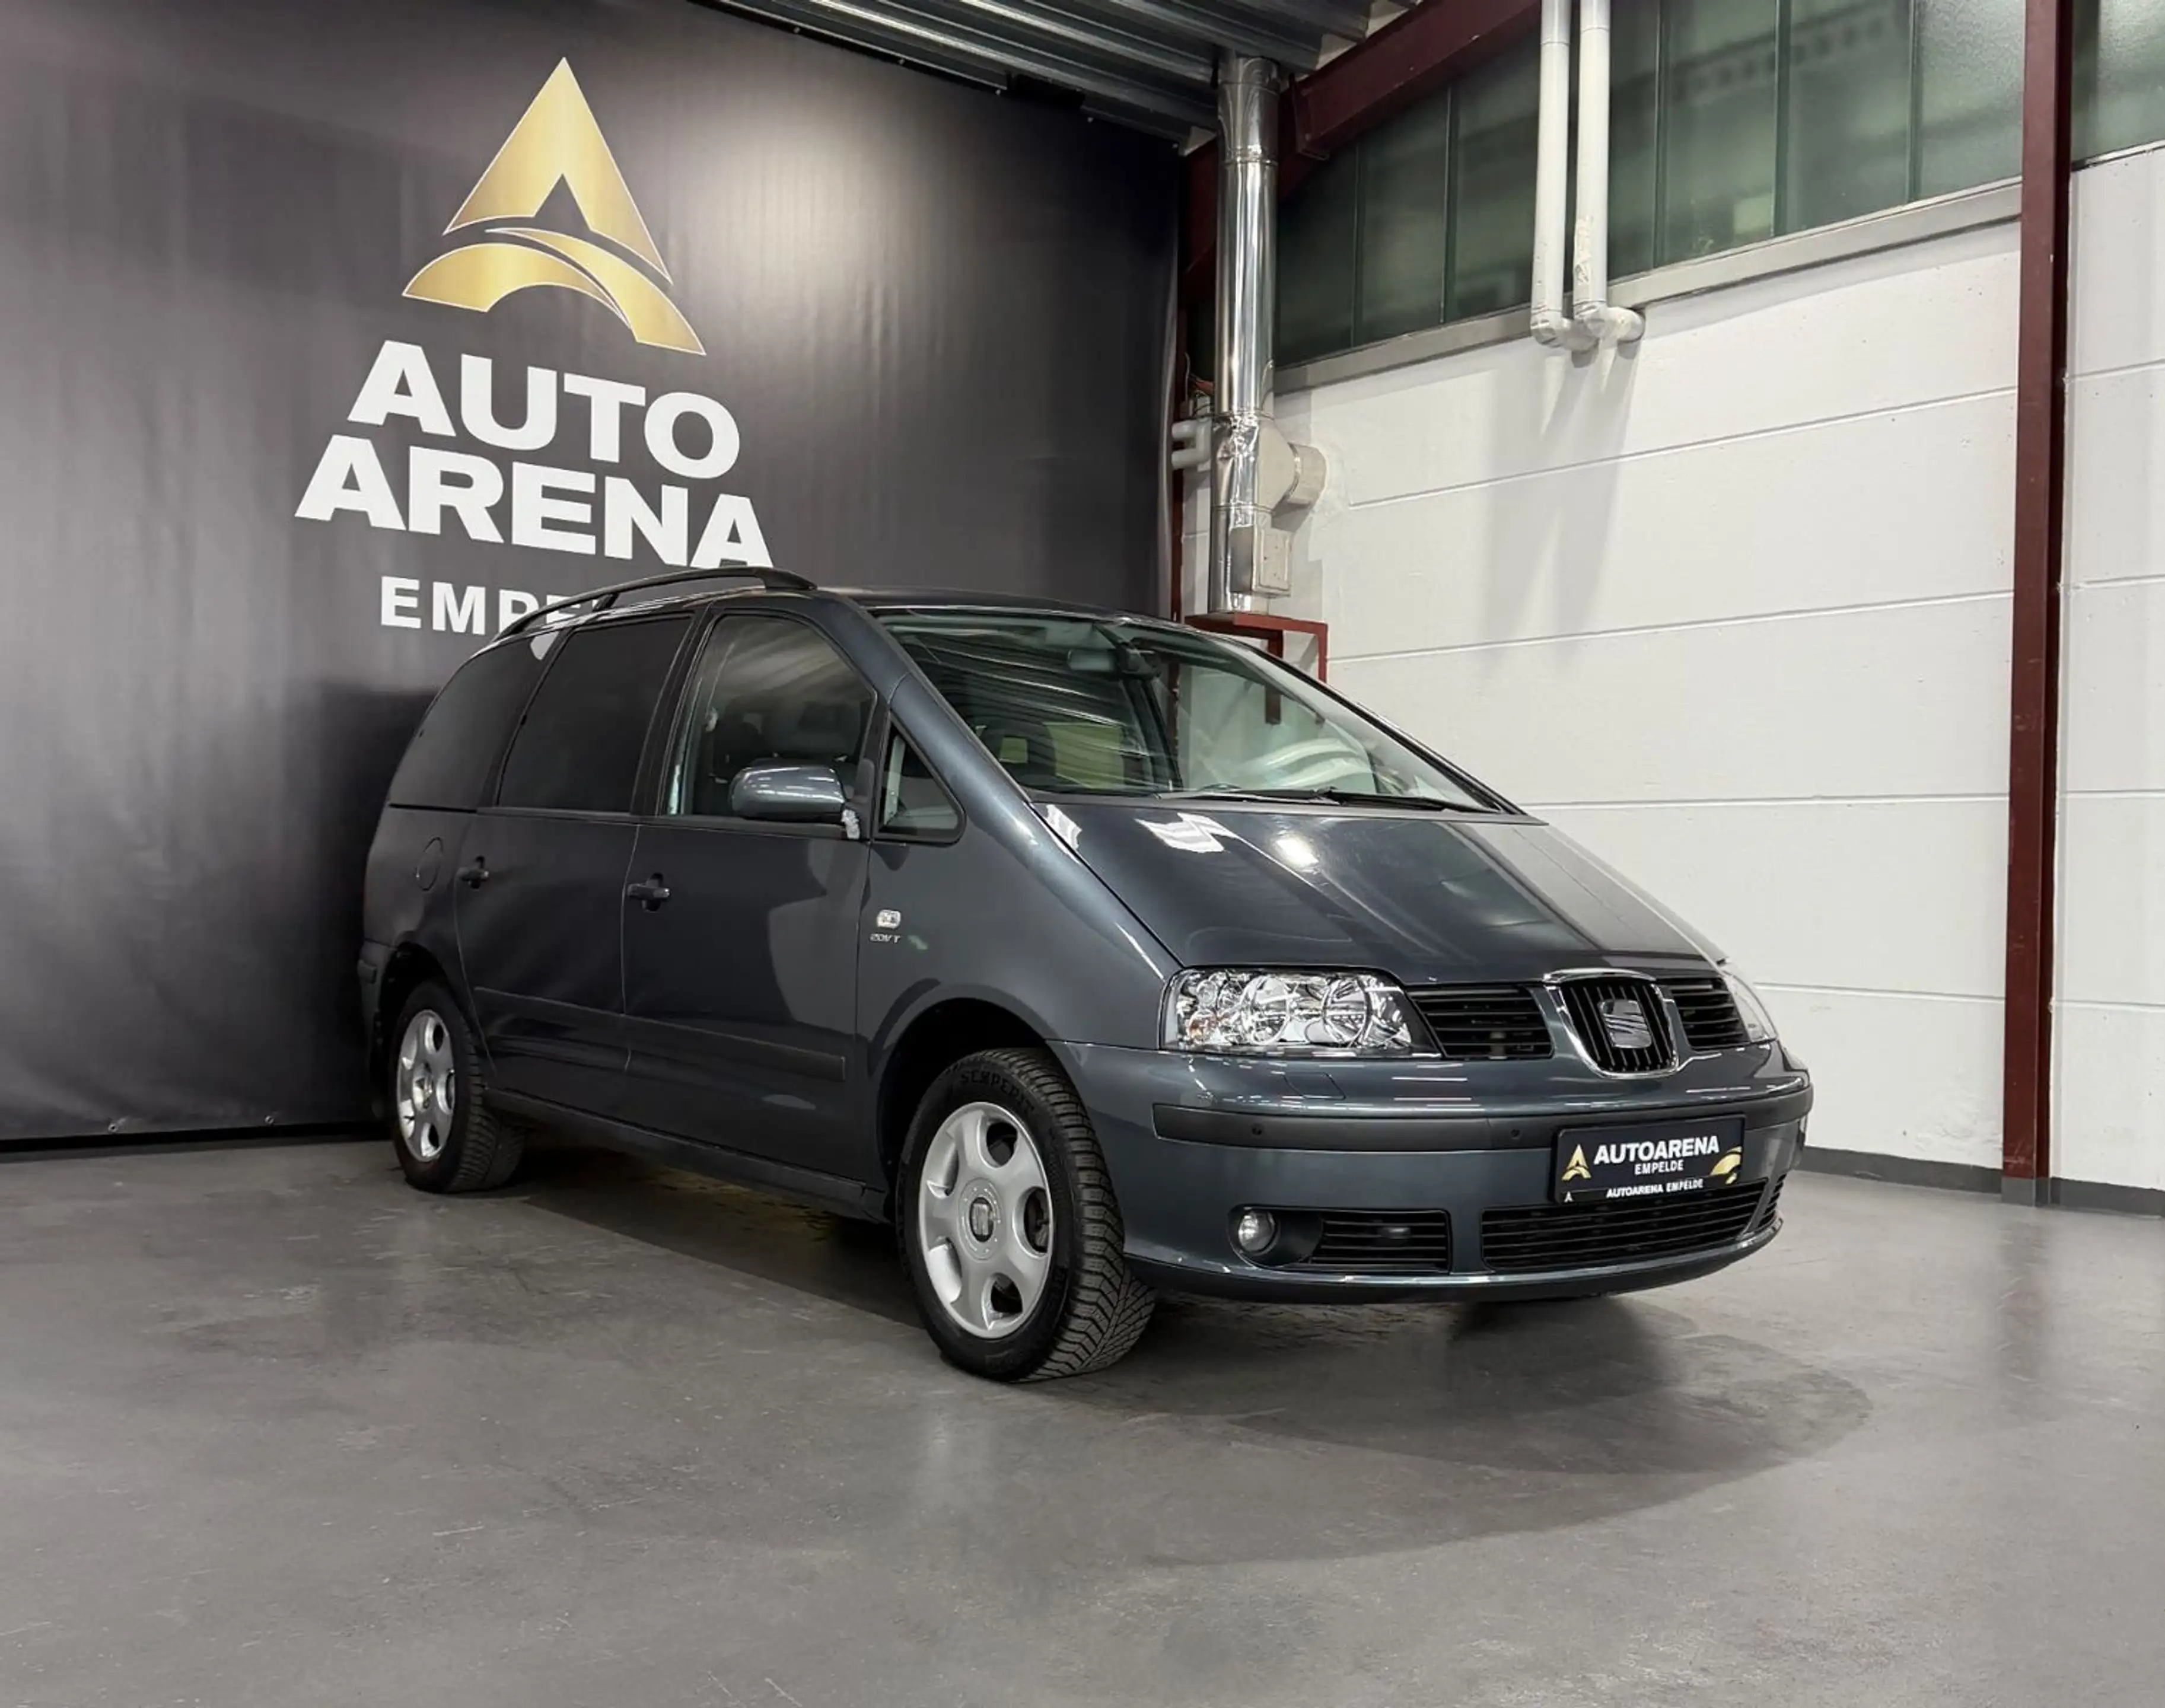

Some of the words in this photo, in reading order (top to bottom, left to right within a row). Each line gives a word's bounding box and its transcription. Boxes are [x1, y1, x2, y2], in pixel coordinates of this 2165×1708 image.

[347, 340, 740, 479] AUTO
[294, 435, 774, 569] ARENA
[1594, 1136, 1719, 1165] AUTOARENA
[1635, 1159, 1684, 1175] EMPELDE
[1606, 1184, 1663, 1198] AUTOARENA
[1666, 1178, 1704, 1192] EMPELDE
